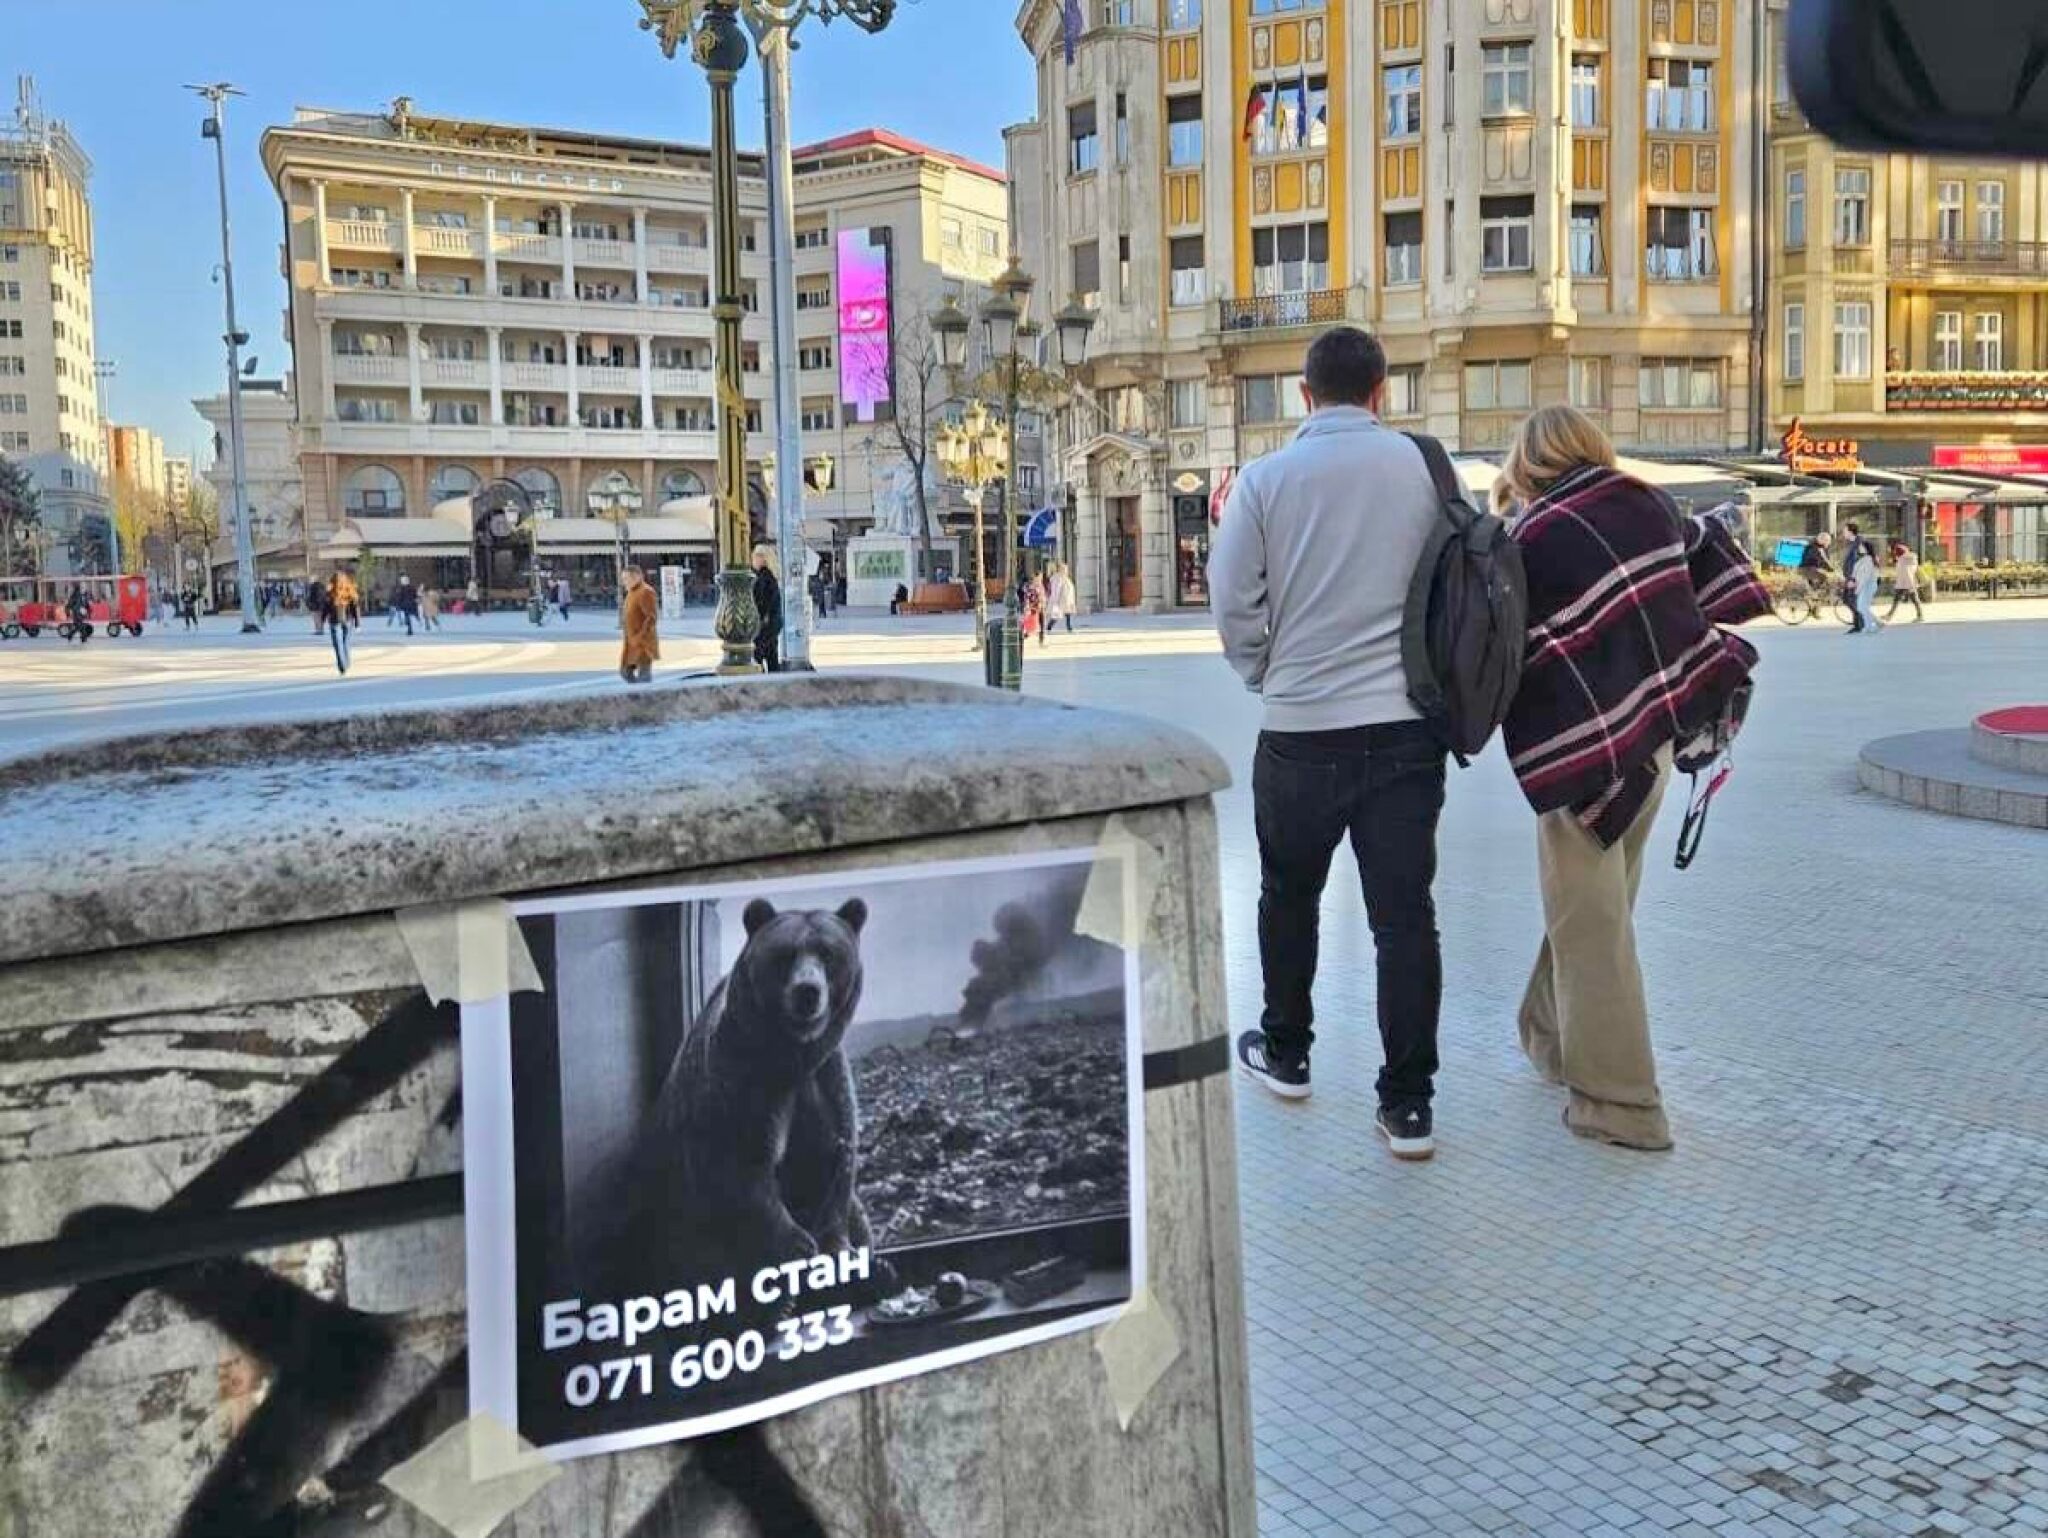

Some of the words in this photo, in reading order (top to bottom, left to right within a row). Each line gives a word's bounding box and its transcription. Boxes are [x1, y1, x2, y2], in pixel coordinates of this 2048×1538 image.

[542, 1277, 737, 1351] Барам
[751, 1246, 871, 1304] стан
[564, 1354, 653, 1407] 071
[670, 1330, 766, 1388] 600
[777, 1304, 854, 1361] 333
